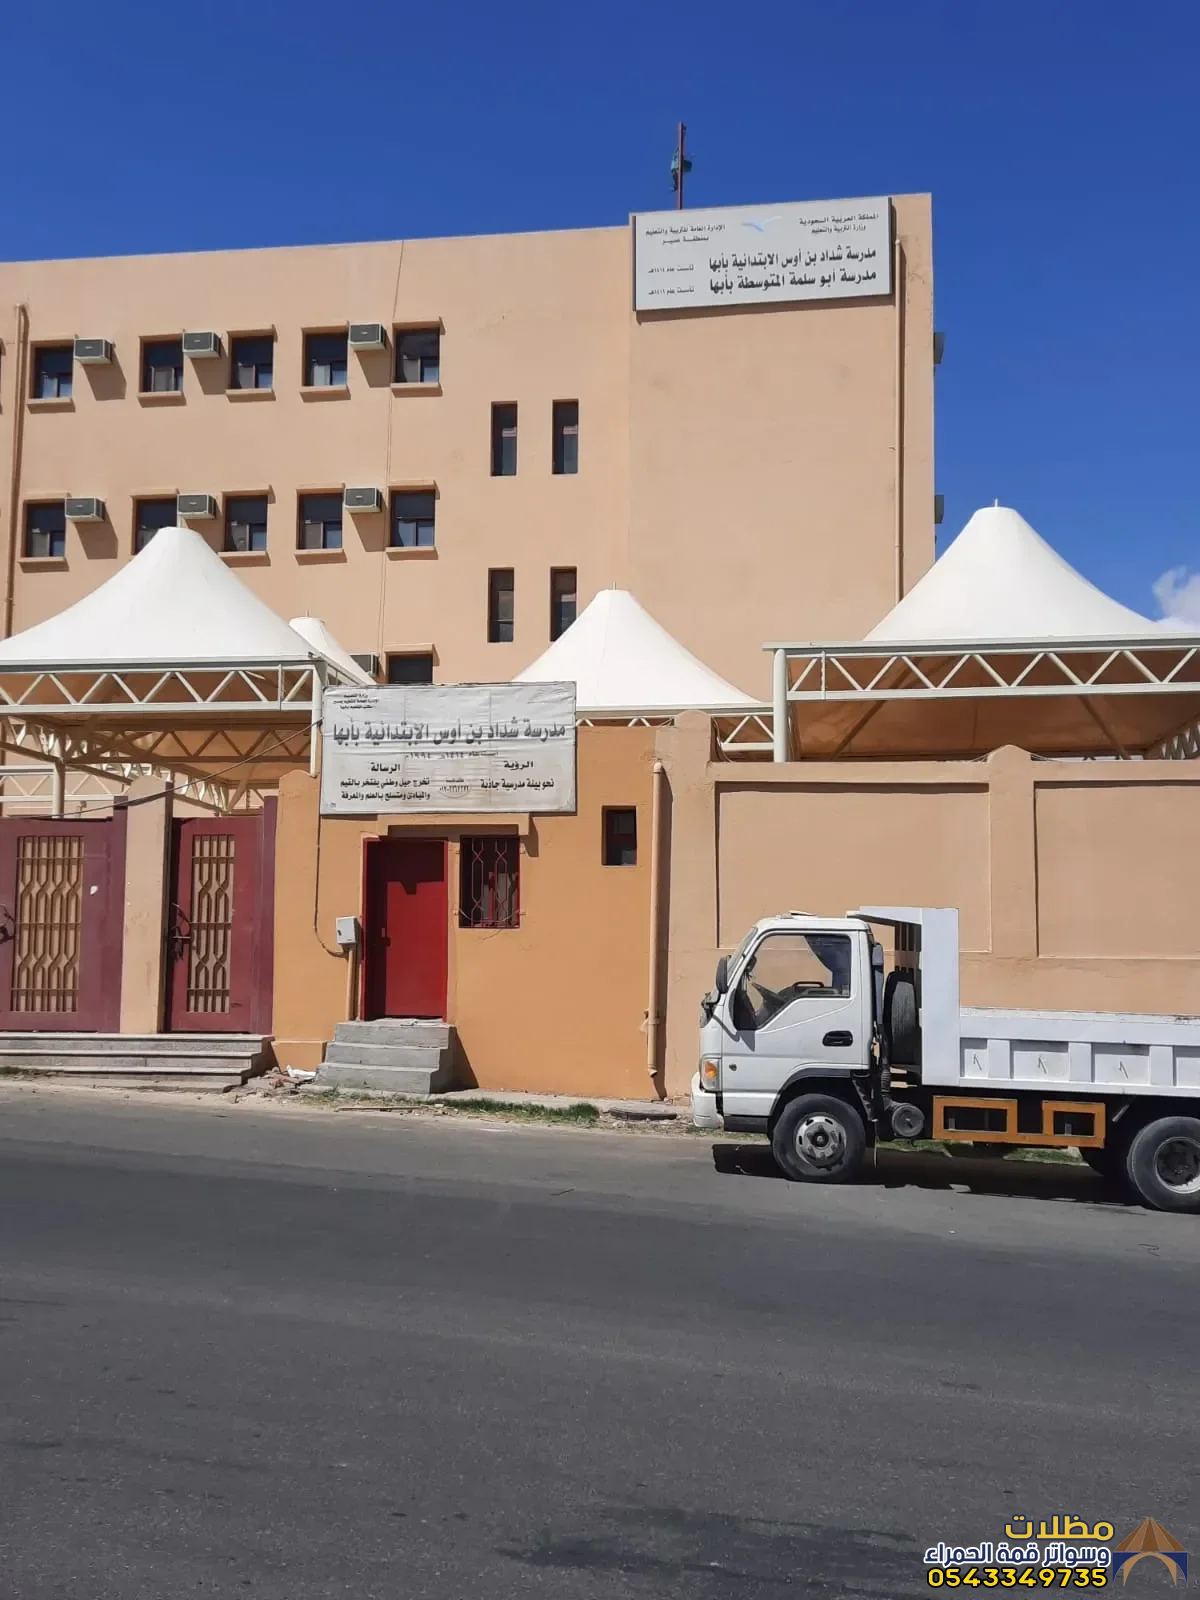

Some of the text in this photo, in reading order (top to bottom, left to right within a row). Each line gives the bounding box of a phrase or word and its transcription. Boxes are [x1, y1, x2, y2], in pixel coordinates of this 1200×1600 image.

[799, 217, 829, 226] السعودية
[831, 215, 856, 224] العربية
[833, 225, 851, 234] التربية
[852, 225, 866, 233] وزارة
[709, 244, 876, 273] مدرسة شداد بن أوس الابتدائية بأبها
[789, 271, 816, 286] سلمة
[840, 268, 877, 285] مدرسة
[710, 274, 734, 295] بأبها
[738, 274, 785, 292] المتوسطة
[333, 716, 566, 746] مدرسة شداد بن أوس الابتدائية بأبها
[370, 762, 401, 774] الرسالة
[503, 760, 533, 771] الرؤية
[340, 778, 360, 788] بالقيم
[381, 778, 398, 789] وطني
[480, 778, 500, 792] جاذبة
[501, 778, 526, 791] مدرسية
